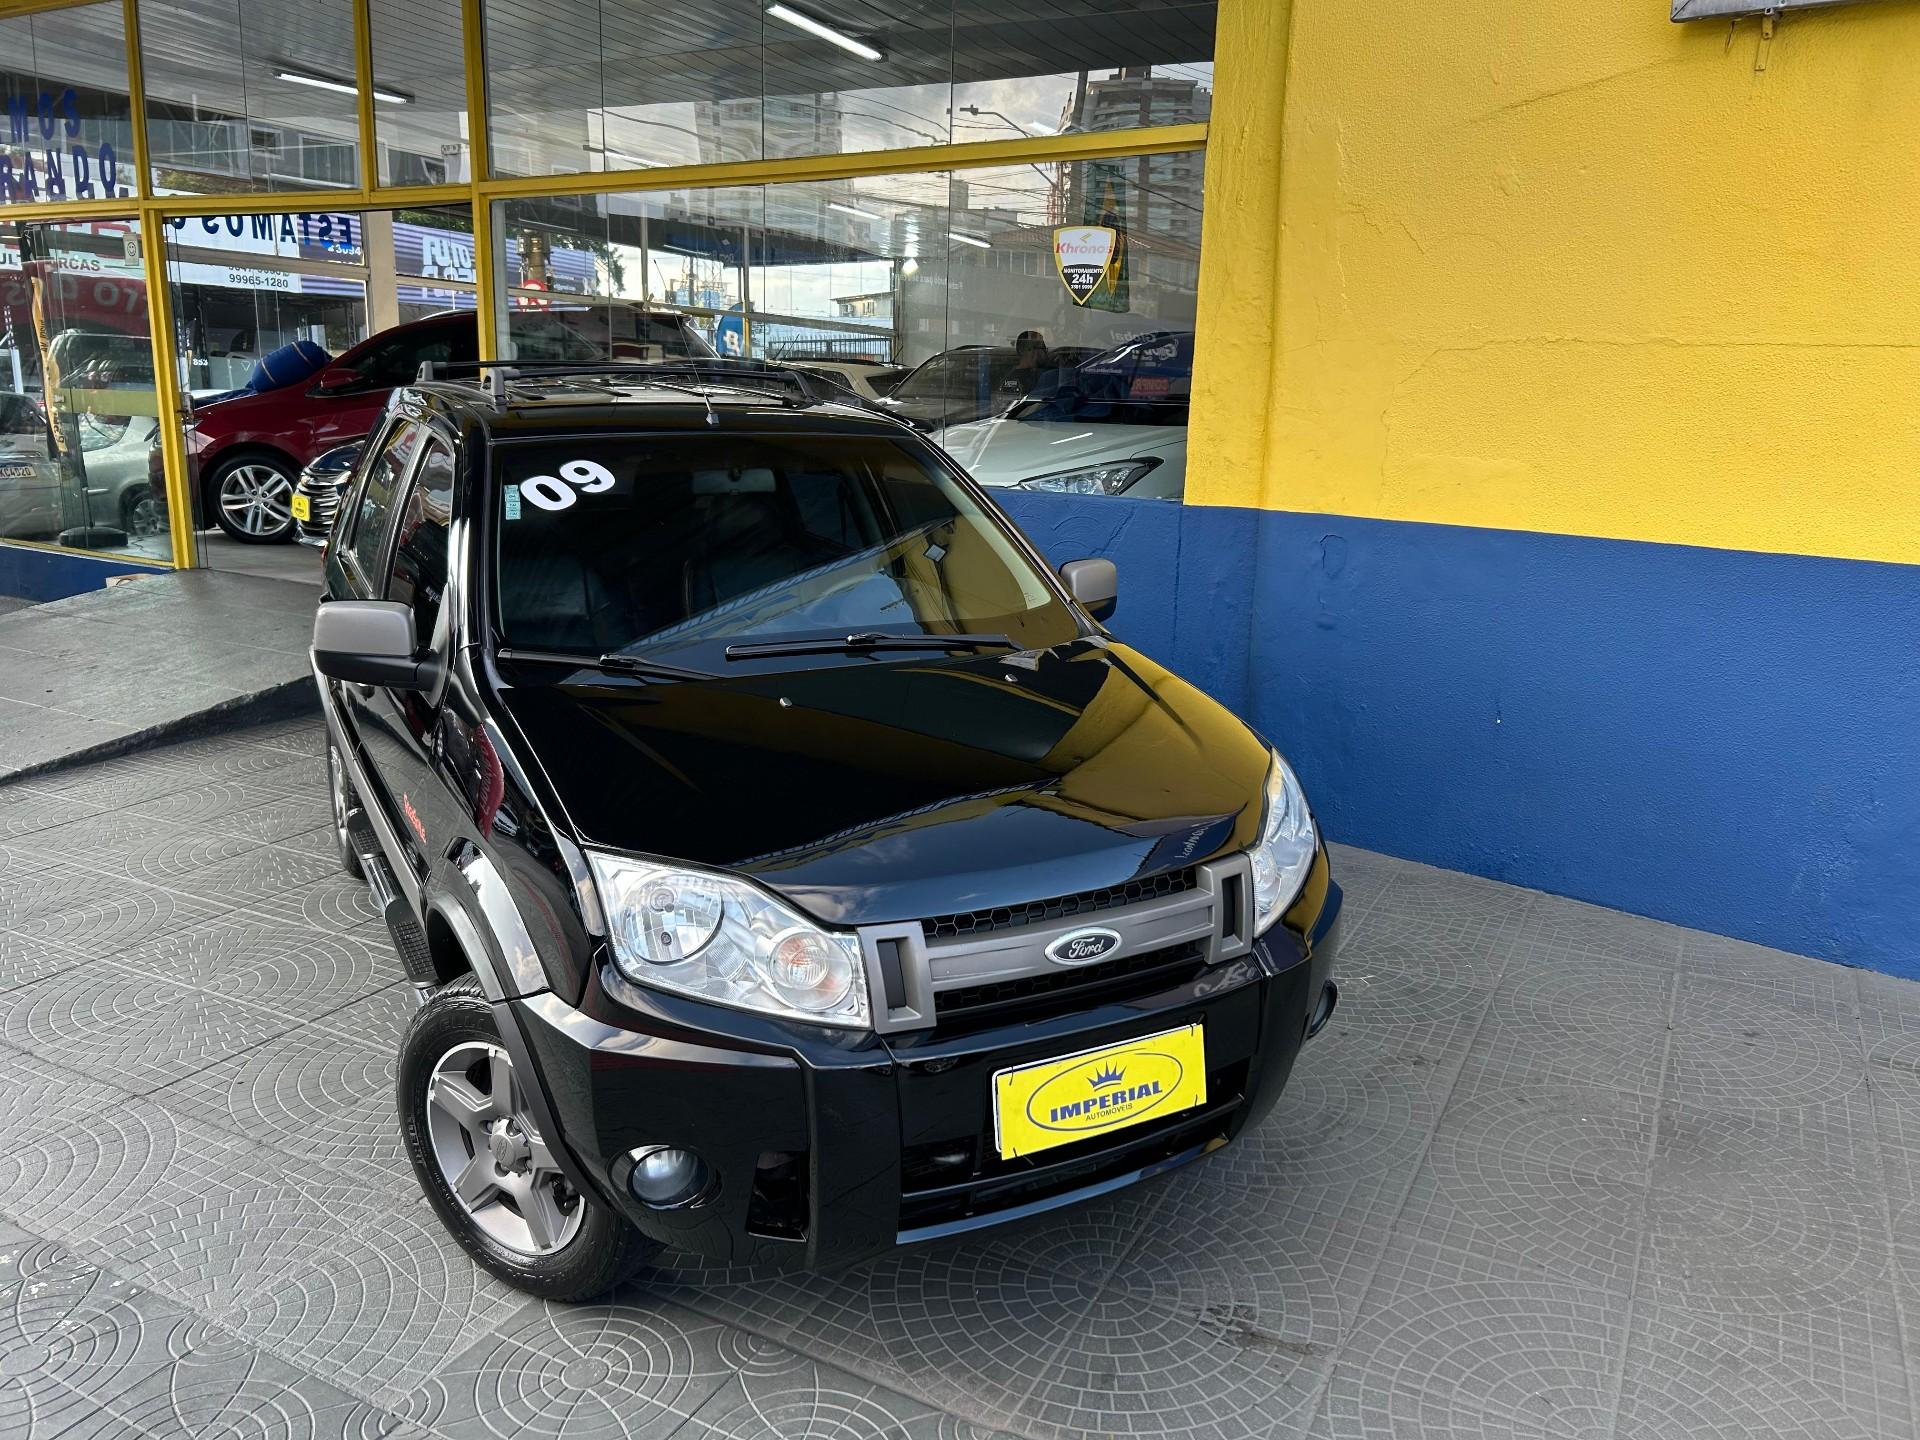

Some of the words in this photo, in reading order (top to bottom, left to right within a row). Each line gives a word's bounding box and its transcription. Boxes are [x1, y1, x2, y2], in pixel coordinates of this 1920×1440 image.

[1056, 243, 1112, 254] Khronos
[229, 273, 288, 288] 99965-1280
[1071, 274, 1093, 284] 24h
[520, 459, 616, 511] 09
[1068, 937, 1104, 958] Ford
[1050, 1080, 1163, 1123] IMPERIAL
